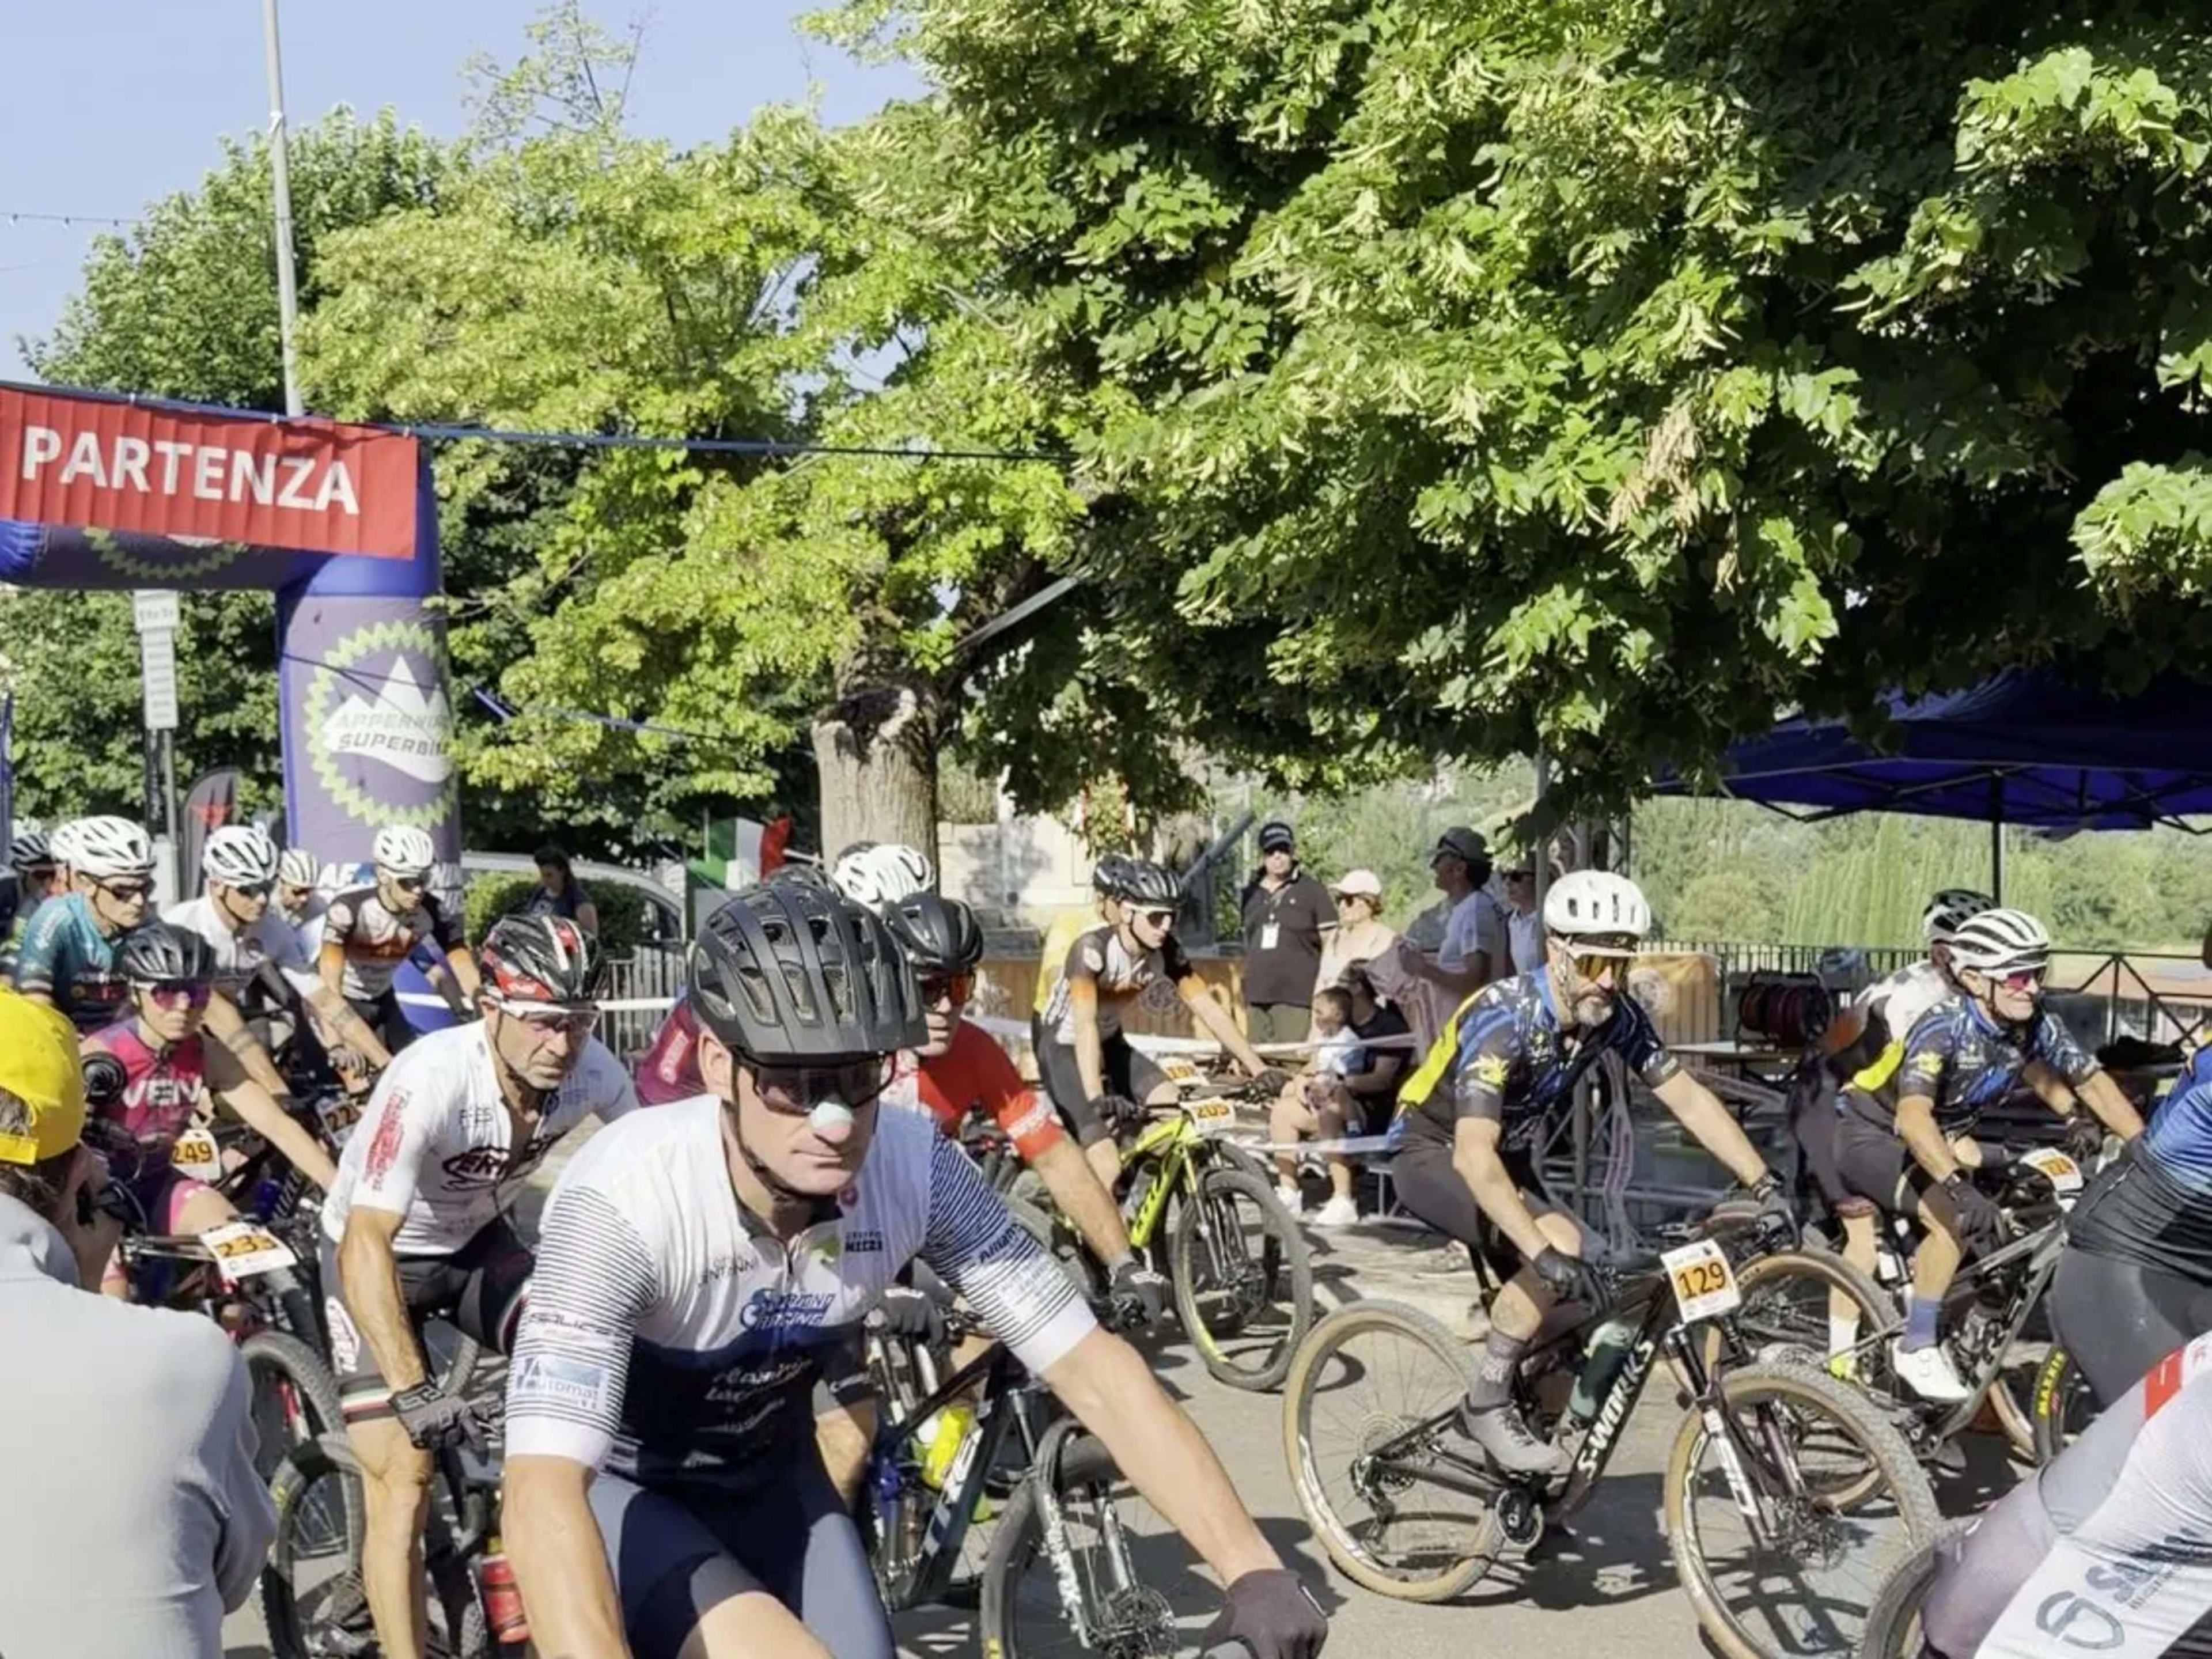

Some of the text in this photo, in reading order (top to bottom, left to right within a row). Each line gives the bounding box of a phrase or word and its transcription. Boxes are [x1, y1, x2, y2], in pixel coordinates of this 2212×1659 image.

[21, 425, 360, 515] PARTENZA
[1677, 1261, 1726, 1300] 129
[1577, 1338, 1655, 1480] S-WORKS
